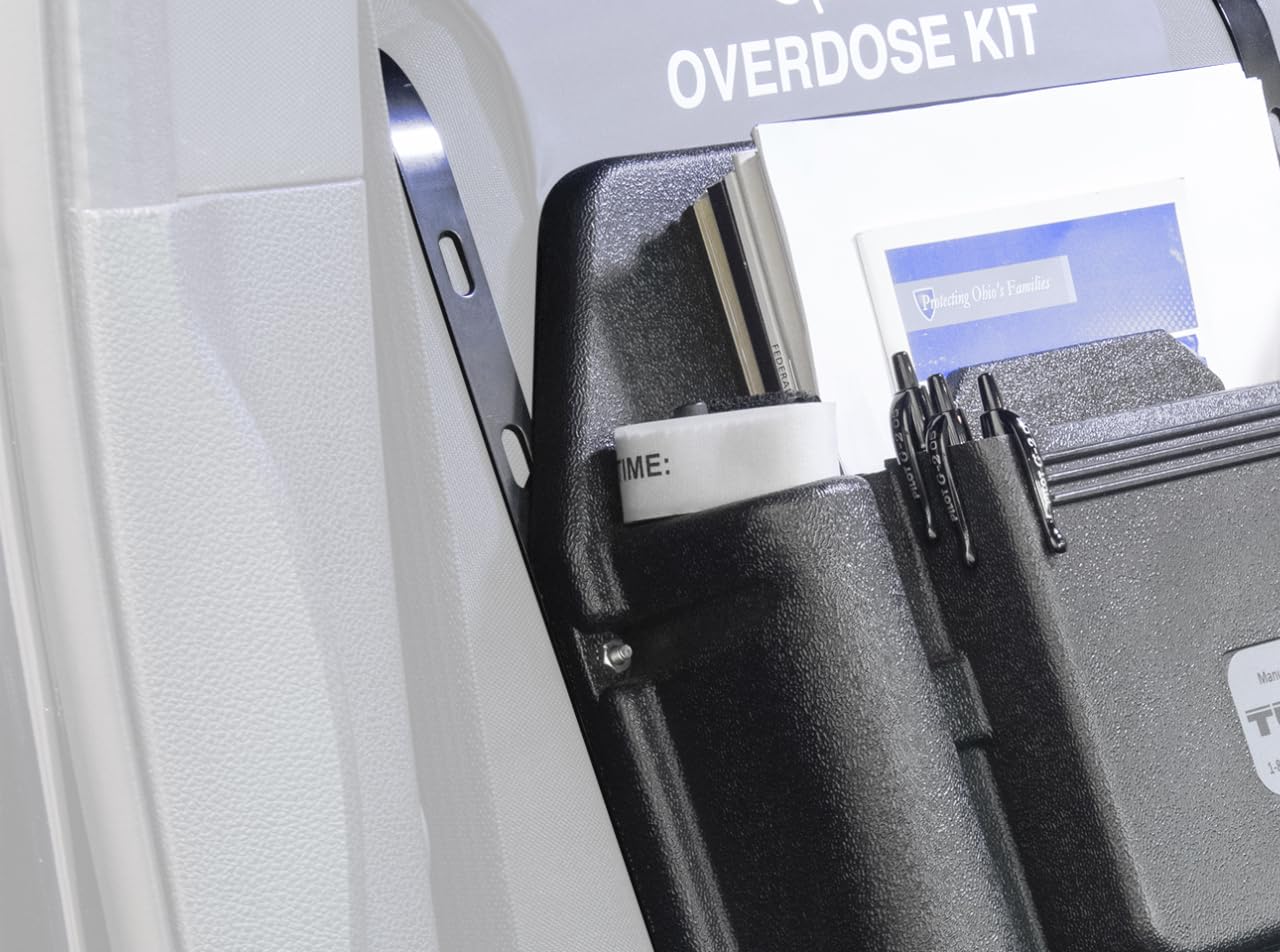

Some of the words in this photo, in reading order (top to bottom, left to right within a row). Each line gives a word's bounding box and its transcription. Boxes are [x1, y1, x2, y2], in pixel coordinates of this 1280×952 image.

[667, 12, 956, 109] OVERDOSE
[968, 3, 1039, 61] KIT
[922, 289, 971, 311] Protecting
[972, 282, 1004, 302] Ohio's
[1007, 275, 1051, 296] Families
[895, 432, 908, 462] G-2
[903, 466, 920, 499] PILOT
[932, 454, 946, 486] G-2
[941, 489, 958, 522] PILOT
